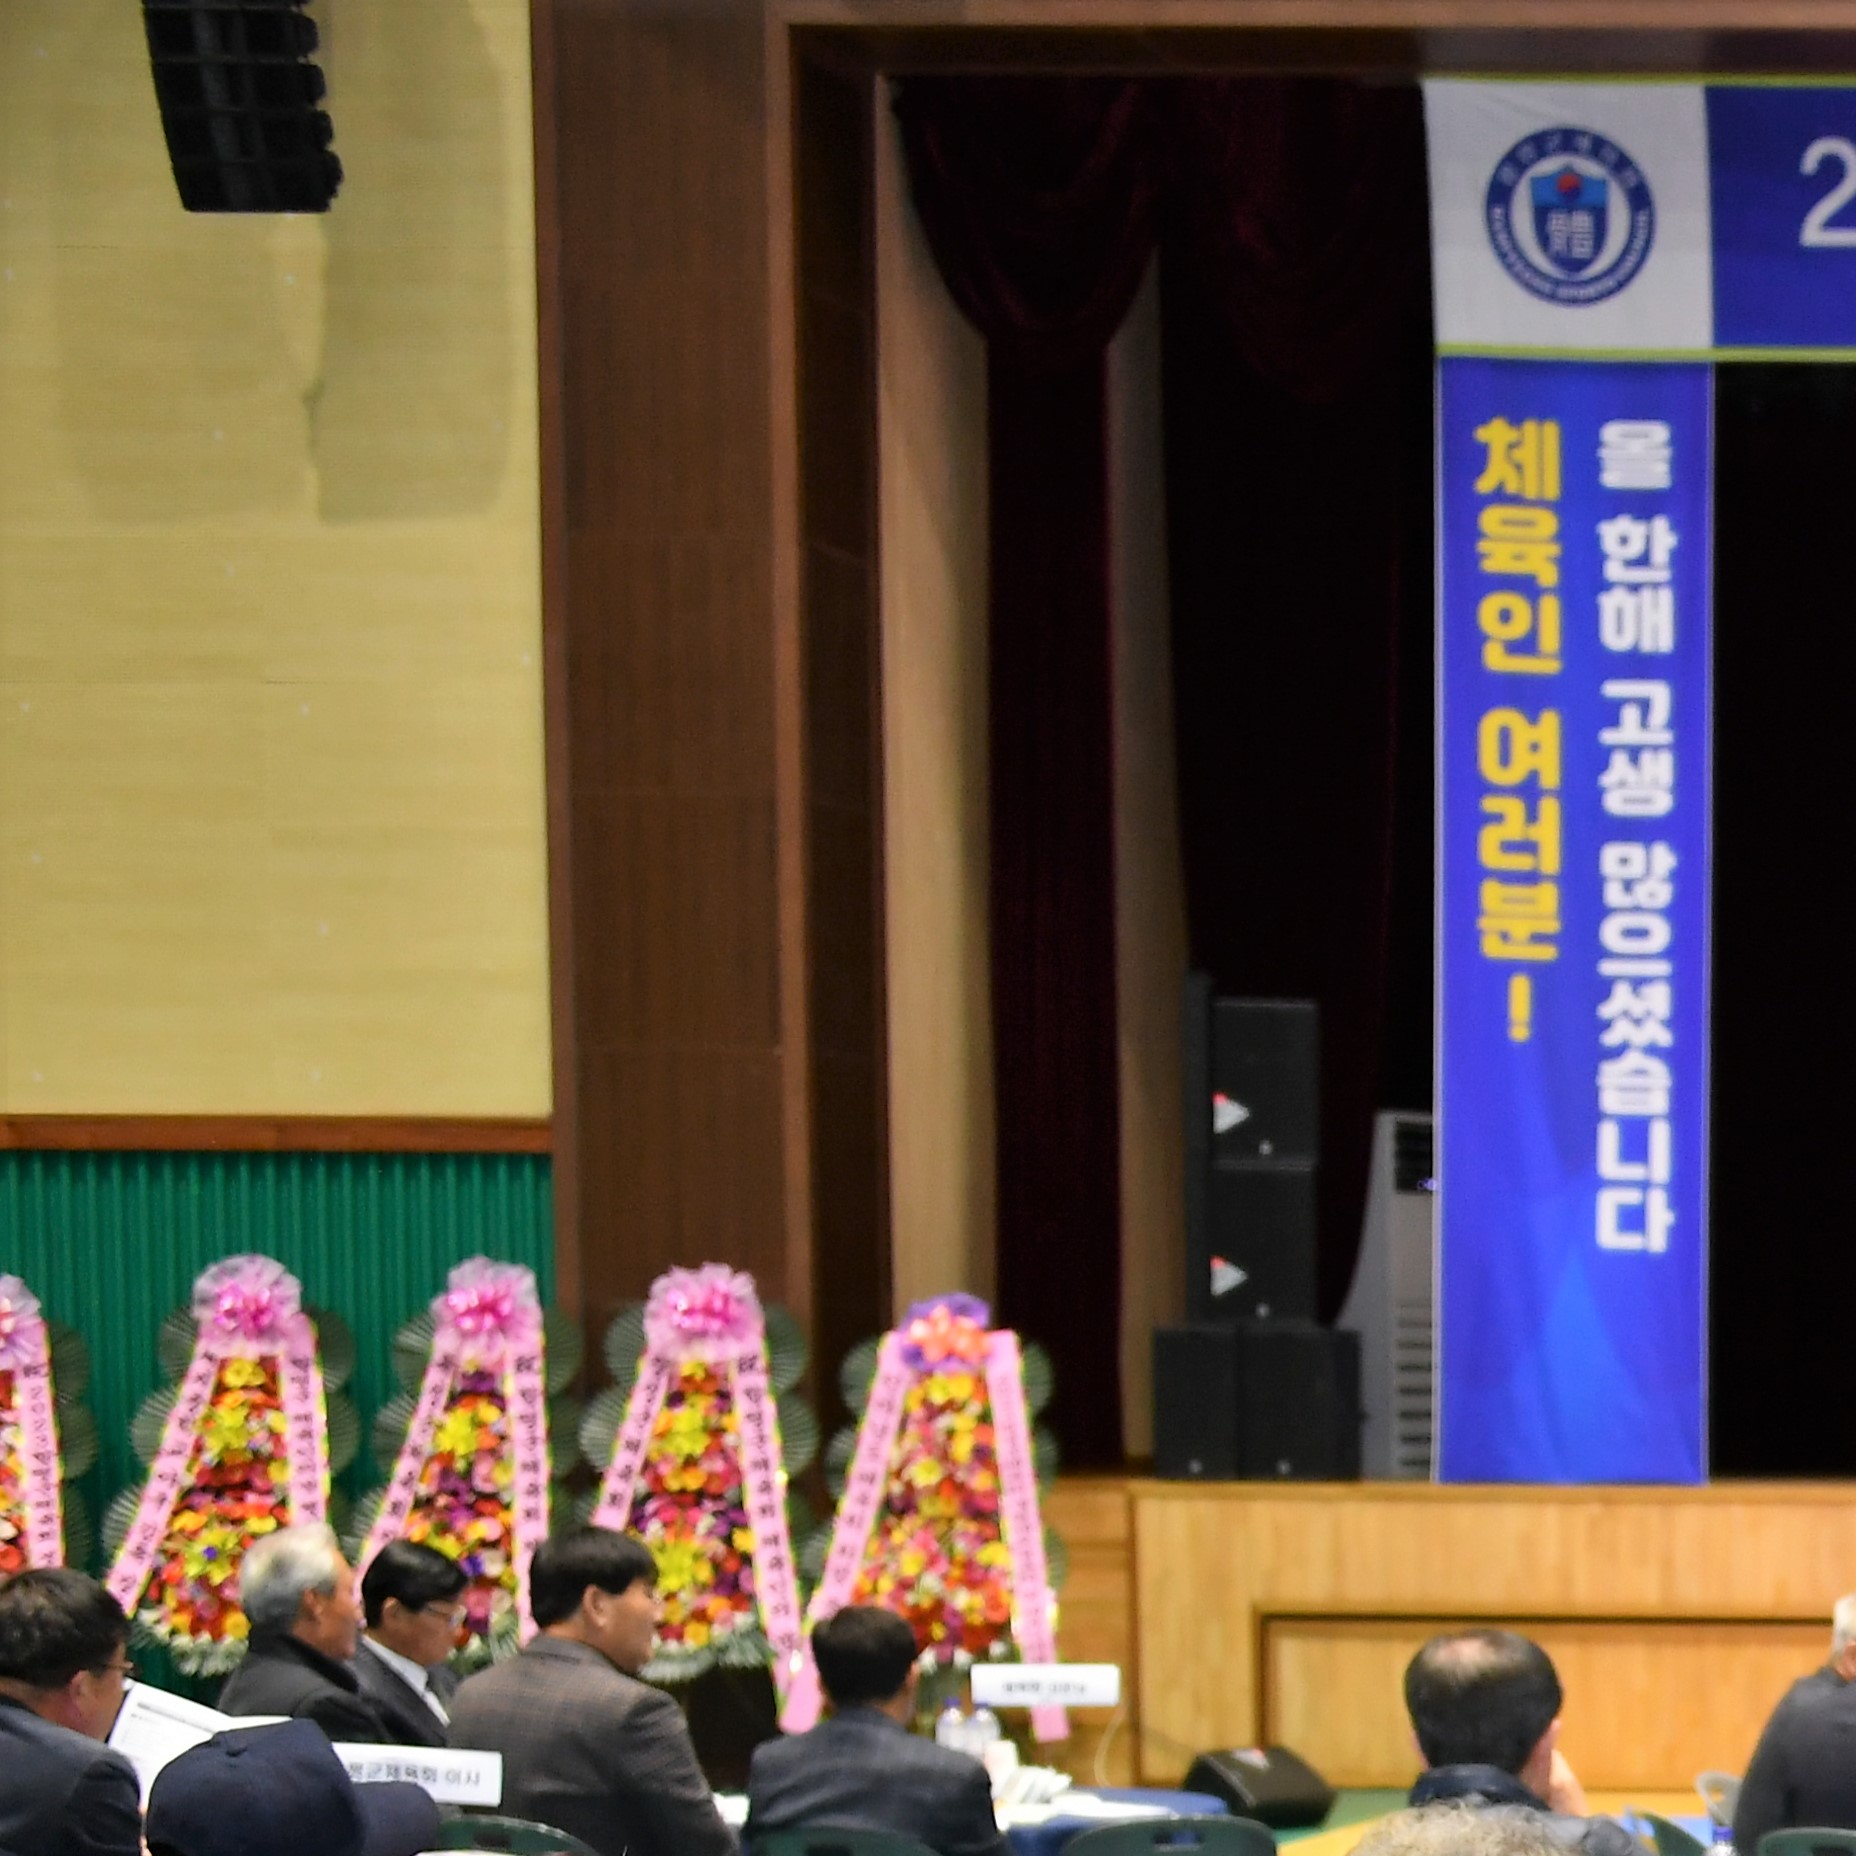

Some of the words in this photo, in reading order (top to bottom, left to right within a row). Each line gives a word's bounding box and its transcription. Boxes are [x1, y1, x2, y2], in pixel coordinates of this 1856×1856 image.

[1597, 419, 1674, 491] 올
[1474, 416, 1563, 676] 체육인
[1596, 513, 1679, 655] 한해
[1597, 677, 1676, 819] 고생
[1476, 706, 1563, 963] 여러분
